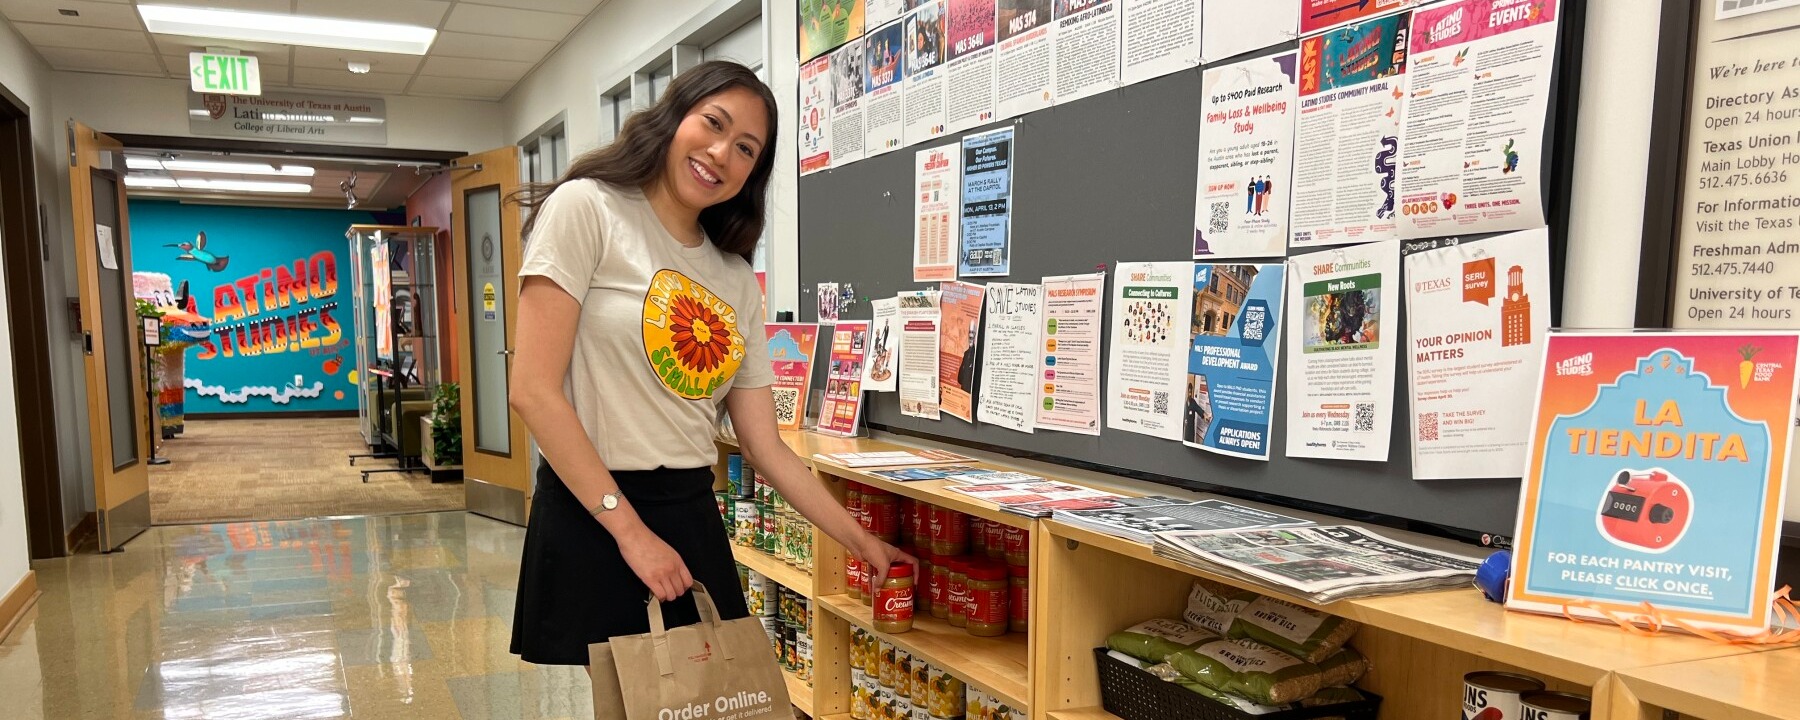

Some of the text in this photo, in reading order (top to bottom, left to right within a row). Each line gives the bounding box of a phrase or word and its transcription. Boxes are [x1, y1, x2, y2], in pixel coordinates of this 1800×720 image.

[1009, 9, 1036, 34] MAS 374
[1060, 3, 1113, 28] REMIXING AFRO-LATINIDAD
[1488, 2, 1532, 28] EVENTS
[955, 36, 967, 55] MAS
[967, 32, 984, 50] 364U
[202, 56, 249, 90] EXIT
[1710, 59, 1785, 80] We're here
[872, 74, 881, 88] MAS
[1212, 83, 1282, 105] Up to $400 Paid Research
[1302, 82, 1388, 108] LATINO STUDIES COMMUNITY MURAL
[1706, 91, 1774, 109] Directory
[232, 96, 248, 105] The
[249, 97, 294, 109] University
[296, 99, 305, 108] of
[309, 101, 331, 110] Texas
[344, 104, 372, 112] Austin
[1207, 101, 1287, 124] Family Loss & Wellbeing
[1704, 116, 1738, 130] Open
[1745, 111, 1760, 124] 24
[234, 122, 324, 135] College of Liberal Arts
[1234, 120, 1254, 135] Study
[1704, 135, 1790, 153] Texas Union
[1701, 160, 1730, 172] Main
[1737, 156, 1776, 169] Lobby
[1699, 170, 1787, 189] 512.475.6636
[1697, 202, 1718, 214] For
[1696, 217, 1792, 232] Visit the Texas
[1693, 244, 1761, 257] Freshman
[1314, 260, 1371, 275] SHARE Communities
[1692, 261, 1774, 276] 512.475.7440
[1131, 273, 1146, 282] SHARE
[1421, 278, 1451, 291] TEXAS
[1464, 271, 1486, 282] SERU
[1058, 288, 1075, 297] RESEARCH
[1075, 288, 1096, 296] SYMPOSIUM
[1128, 289, 1150, 298] Connecting
[1327, 281, 1355, 292] New Roots
[1464, 281, 1489, 290] survey
[990, 286, 1013, 314] SAVE
[1016, 287, 1036, 297] LATINO
[1689, 287, 1762, 302] University
[1767, 287, 1782, 299] of
[1015, 302, 1036, 315] STUDIES
[1688, 306, 1791, 321] Open 24 hours
[646, 273, 744, 362] LATINO STUDIES
[1416, 329, 1492, 348] YOUR OPINION
[774, 348, 786, 357] LA
[1204, 345, 1241, 358] PROFESSIONAL
[1416, 348, 1464, 363] MATTERS
[651, 346, 725, 396] SEMILLAS
[1202, 356, 1258, 371] DEVELOPMENT AWARD
[1634, 399, 1683, 427] LA
[1220, 427, 1261, 440] APPLICATIONS
[1218, 436, 1260, 449] ALWAYS OPEN!
[1566, 428, 1748, 463] TIENDITA
[1547, 552, 1732, 582] FOR EACH PANTRY VISIT,
[1561, 570, 1713, 596] PLEASE CLICK ONCE.
[1254, 610, 1296, 631] BROWN RICE
[1218, 649, 1248, 666] BROWN
[658, 690, 772, 720] Order Online.
[744, 704, 772, 719] delivered
